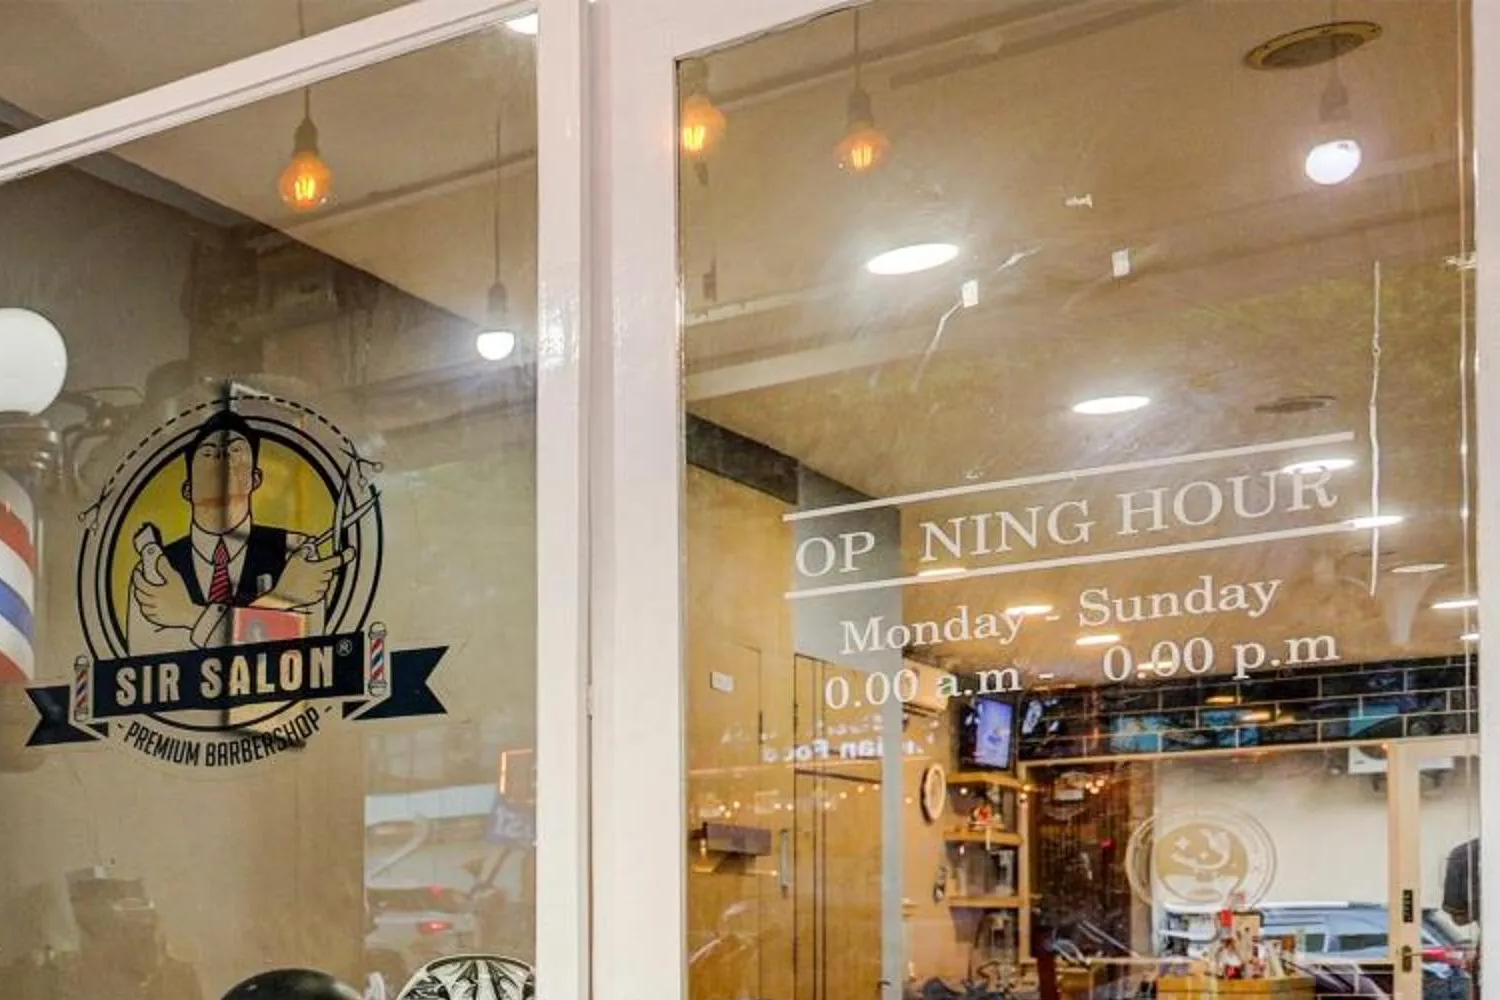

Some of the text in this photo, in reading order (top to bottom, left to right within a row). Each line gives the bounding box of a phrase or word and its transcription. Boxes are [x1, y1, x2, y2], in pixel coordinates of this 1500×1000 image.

[1115, 463, 1338, 536] HOUR
[840, 605, 1024, 655] Monday
[1078, 575, 1283, 627] Sunday
[116, 663, 181, 707] SIR
[1232, 634, 1341, 681] p.m
[124, 705, 321, 767] PREMIUM BARBERSHOP
